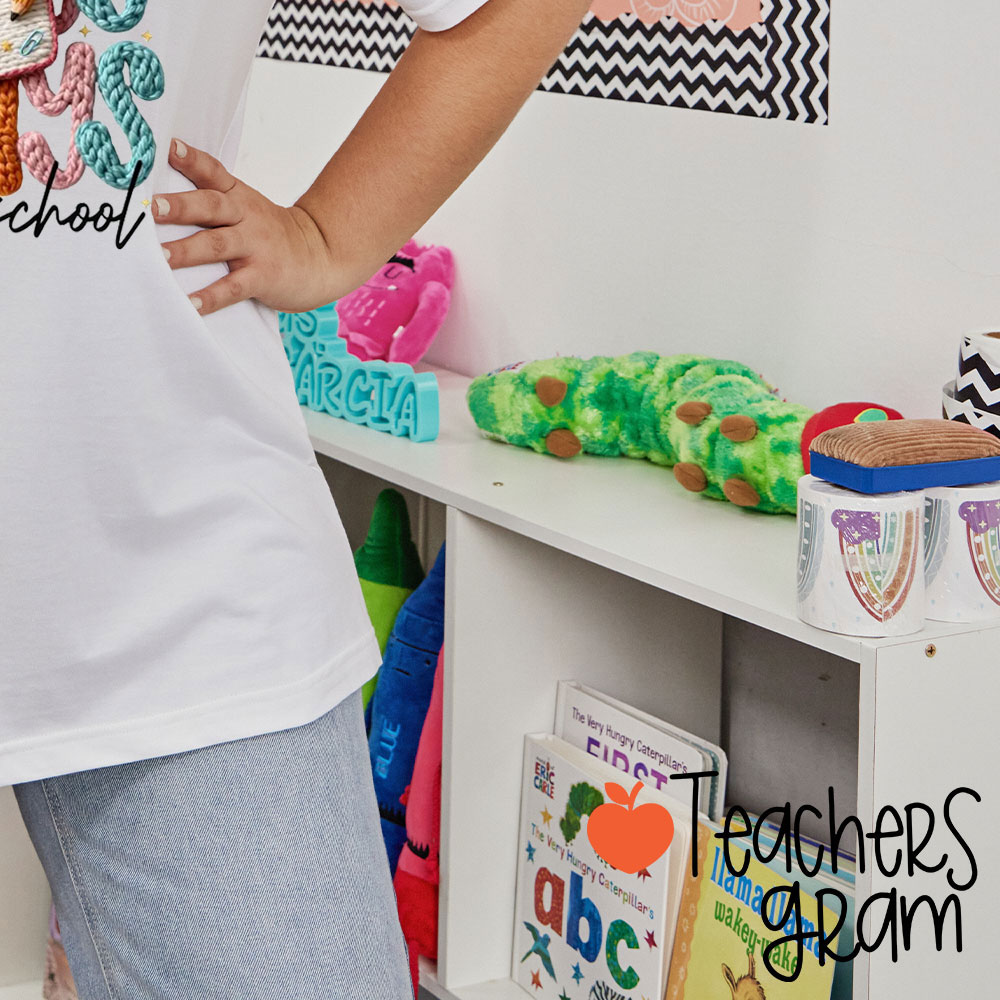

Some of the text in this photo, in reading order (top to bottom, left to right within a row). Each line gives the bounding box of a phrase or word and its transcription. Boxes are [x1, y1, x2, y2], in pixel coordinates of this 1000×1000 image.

[288, 350, 418, 436] ARCIA
[374, 714, 401, 780] BLUE
[535, 761, 556, 786] ERIC
[573, 706, 688, 774] The Very Hungry Caterpillar's
[534, 775, 555, 799] CARLE
[531, 823, 654, 920] The Very Hungry Caterpillar's
[534, 867, 640, 990] abc
